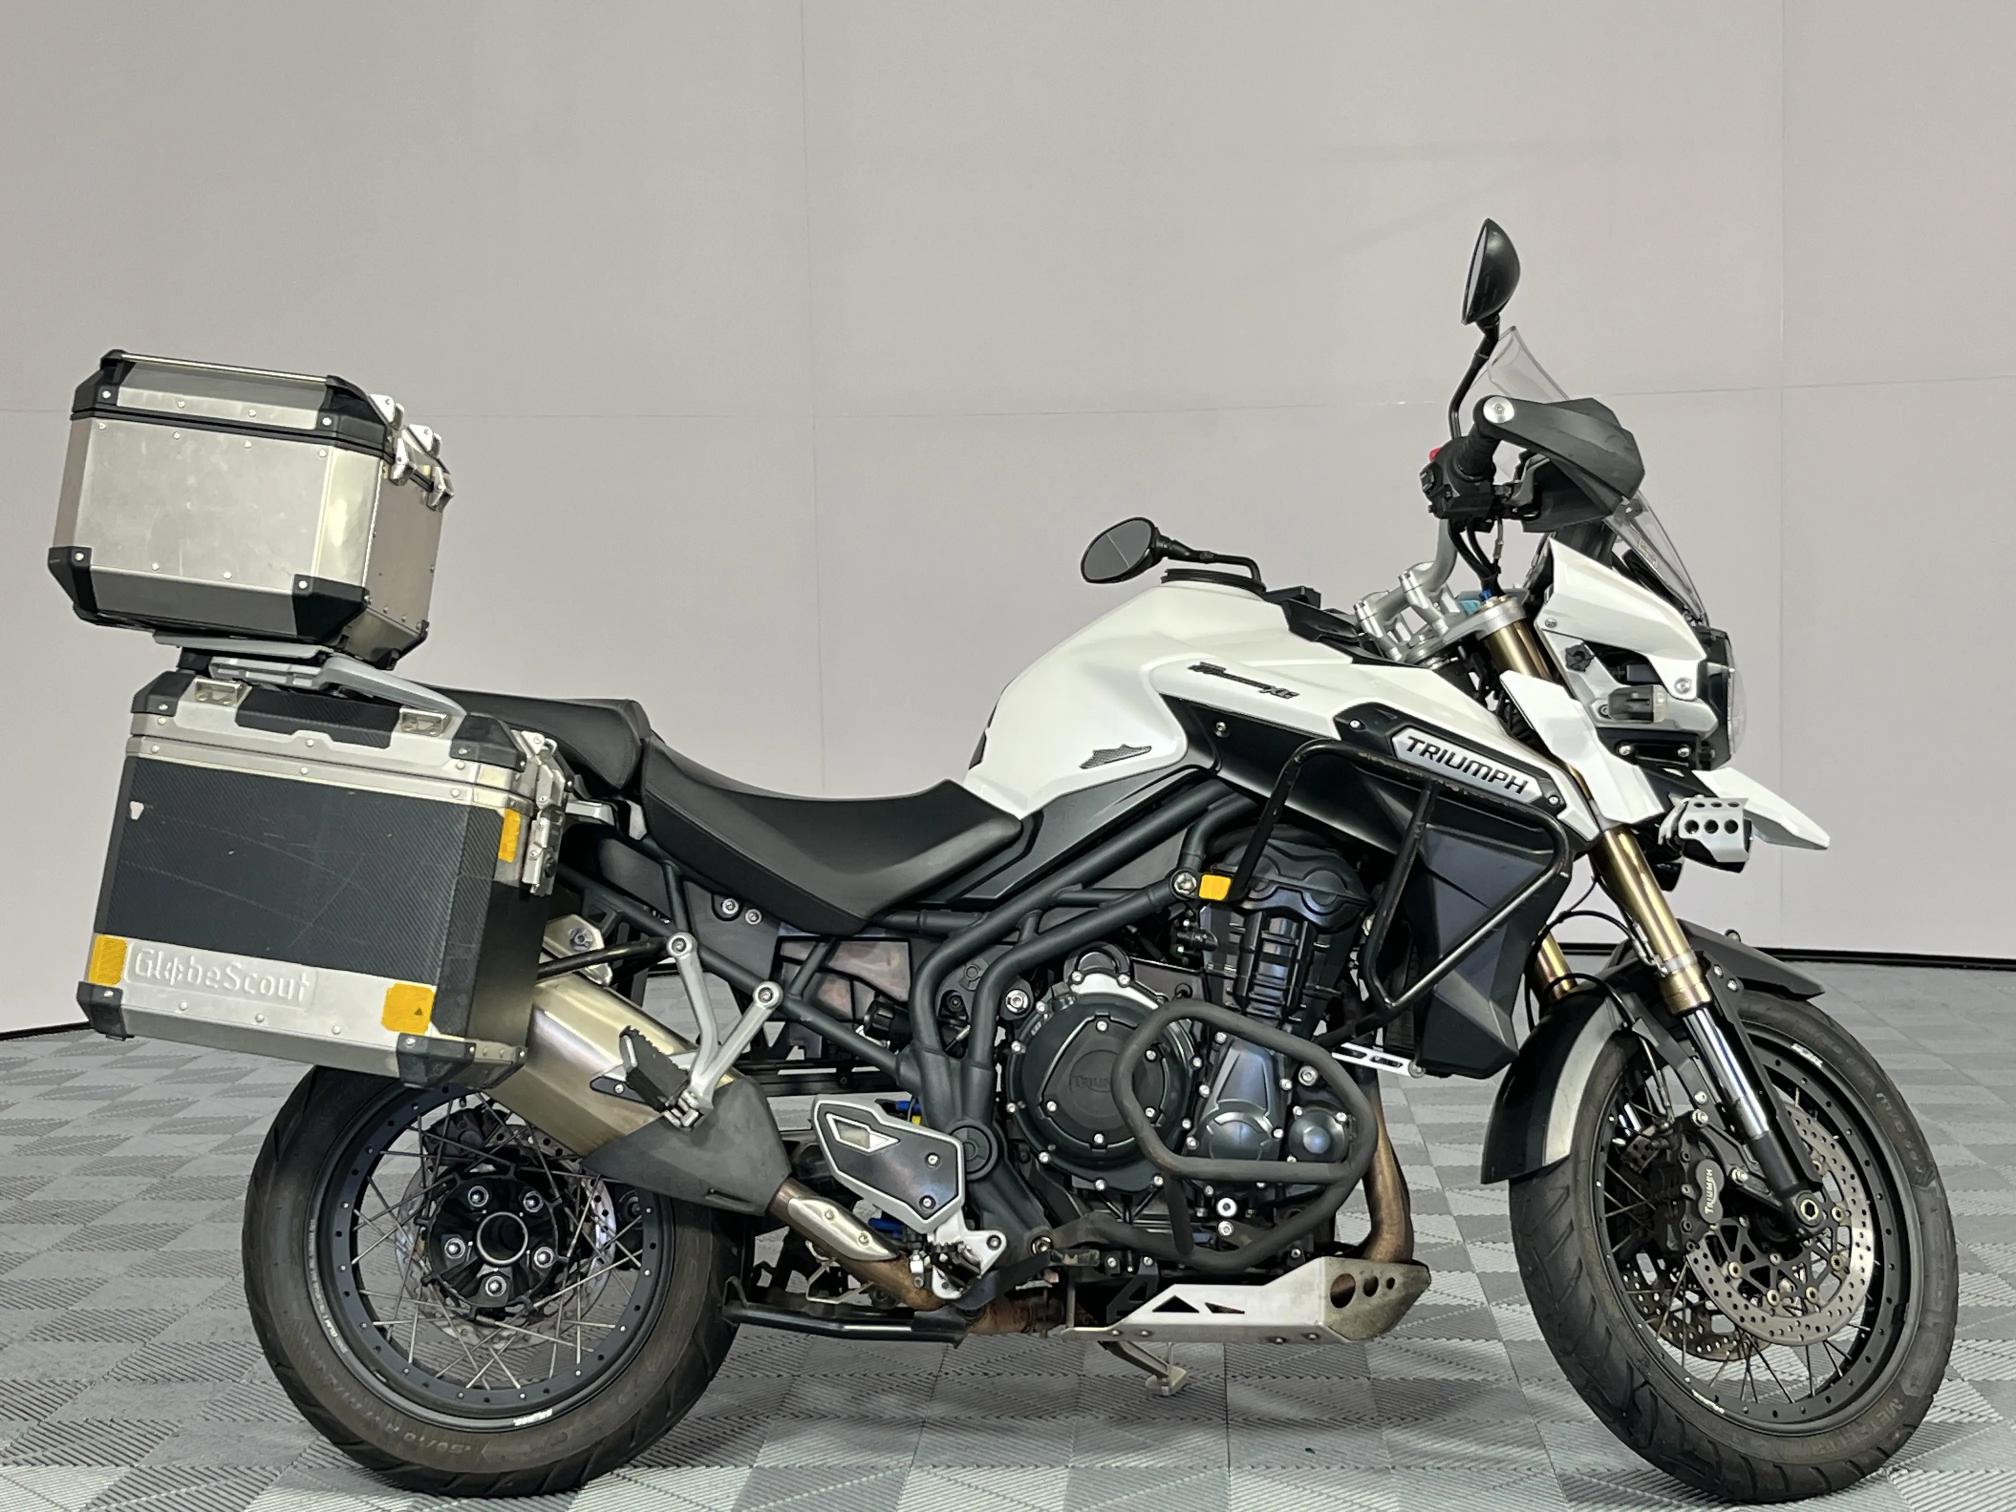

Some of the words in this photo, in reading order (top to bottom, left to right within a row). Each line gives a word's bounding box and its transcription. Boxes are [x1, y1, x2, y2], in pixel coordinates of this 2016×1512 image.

[1407, 735, 1529, 795] TRIUMPH
[135, 949, 310, 1002] GlobeScout
[1704, 1168, 1717, 1215] TRIUMPH
